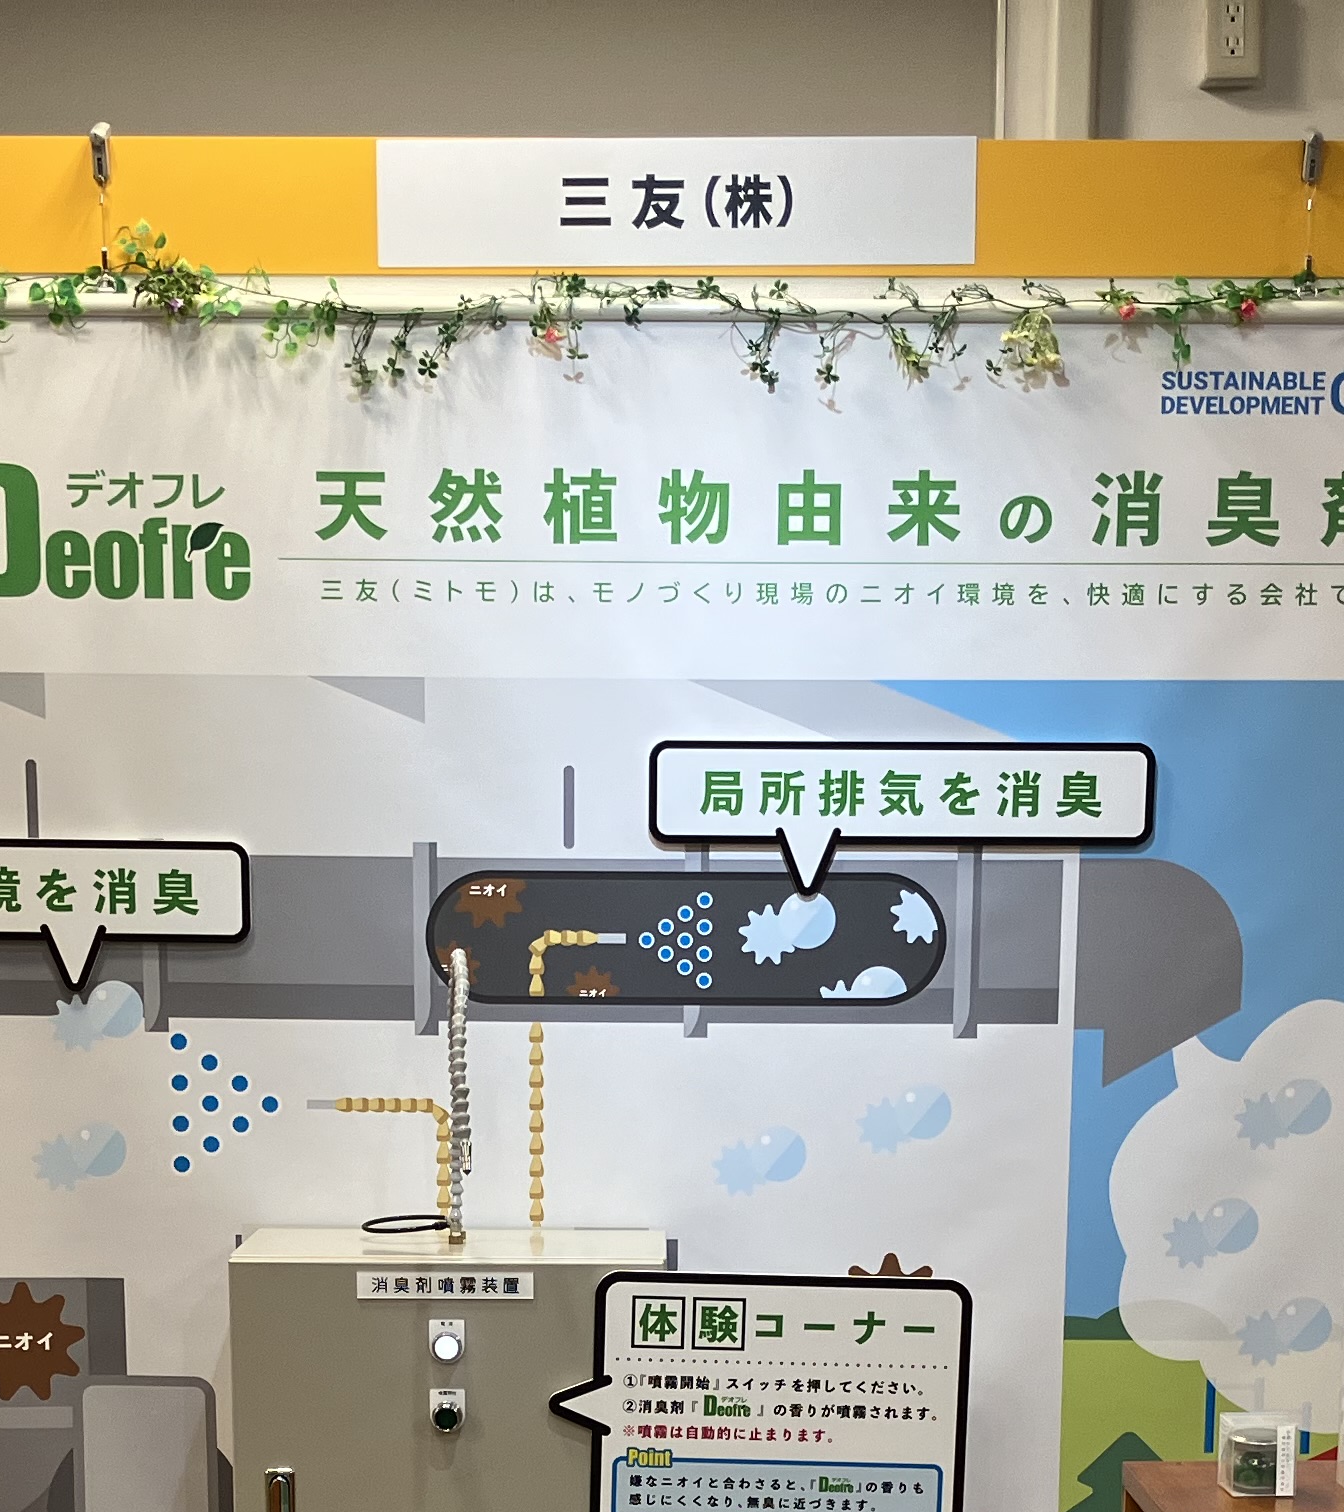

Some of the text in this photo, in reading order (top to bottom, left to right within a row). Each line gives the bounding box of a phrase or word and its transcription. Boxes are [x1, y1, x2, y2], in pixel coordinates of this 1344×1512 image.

[1160, 371, 1326, 391] SUSTAINABLE
[1160, 395, 1326, 415] DEVELOPMENT
[65, 470, 226, 510] デオフレ
[699, 769, 1103, 820] 局所排気を消臭
[468, 883, 508, 897] ニオイ
[578, 988, 607, 998] ニオイ
[371, 1276, 520, 1294] 消臭剤噴霧装置
[638, 1303, 936, 1345] 体験コーナー
[627, 1447, 673, 1468] Point
